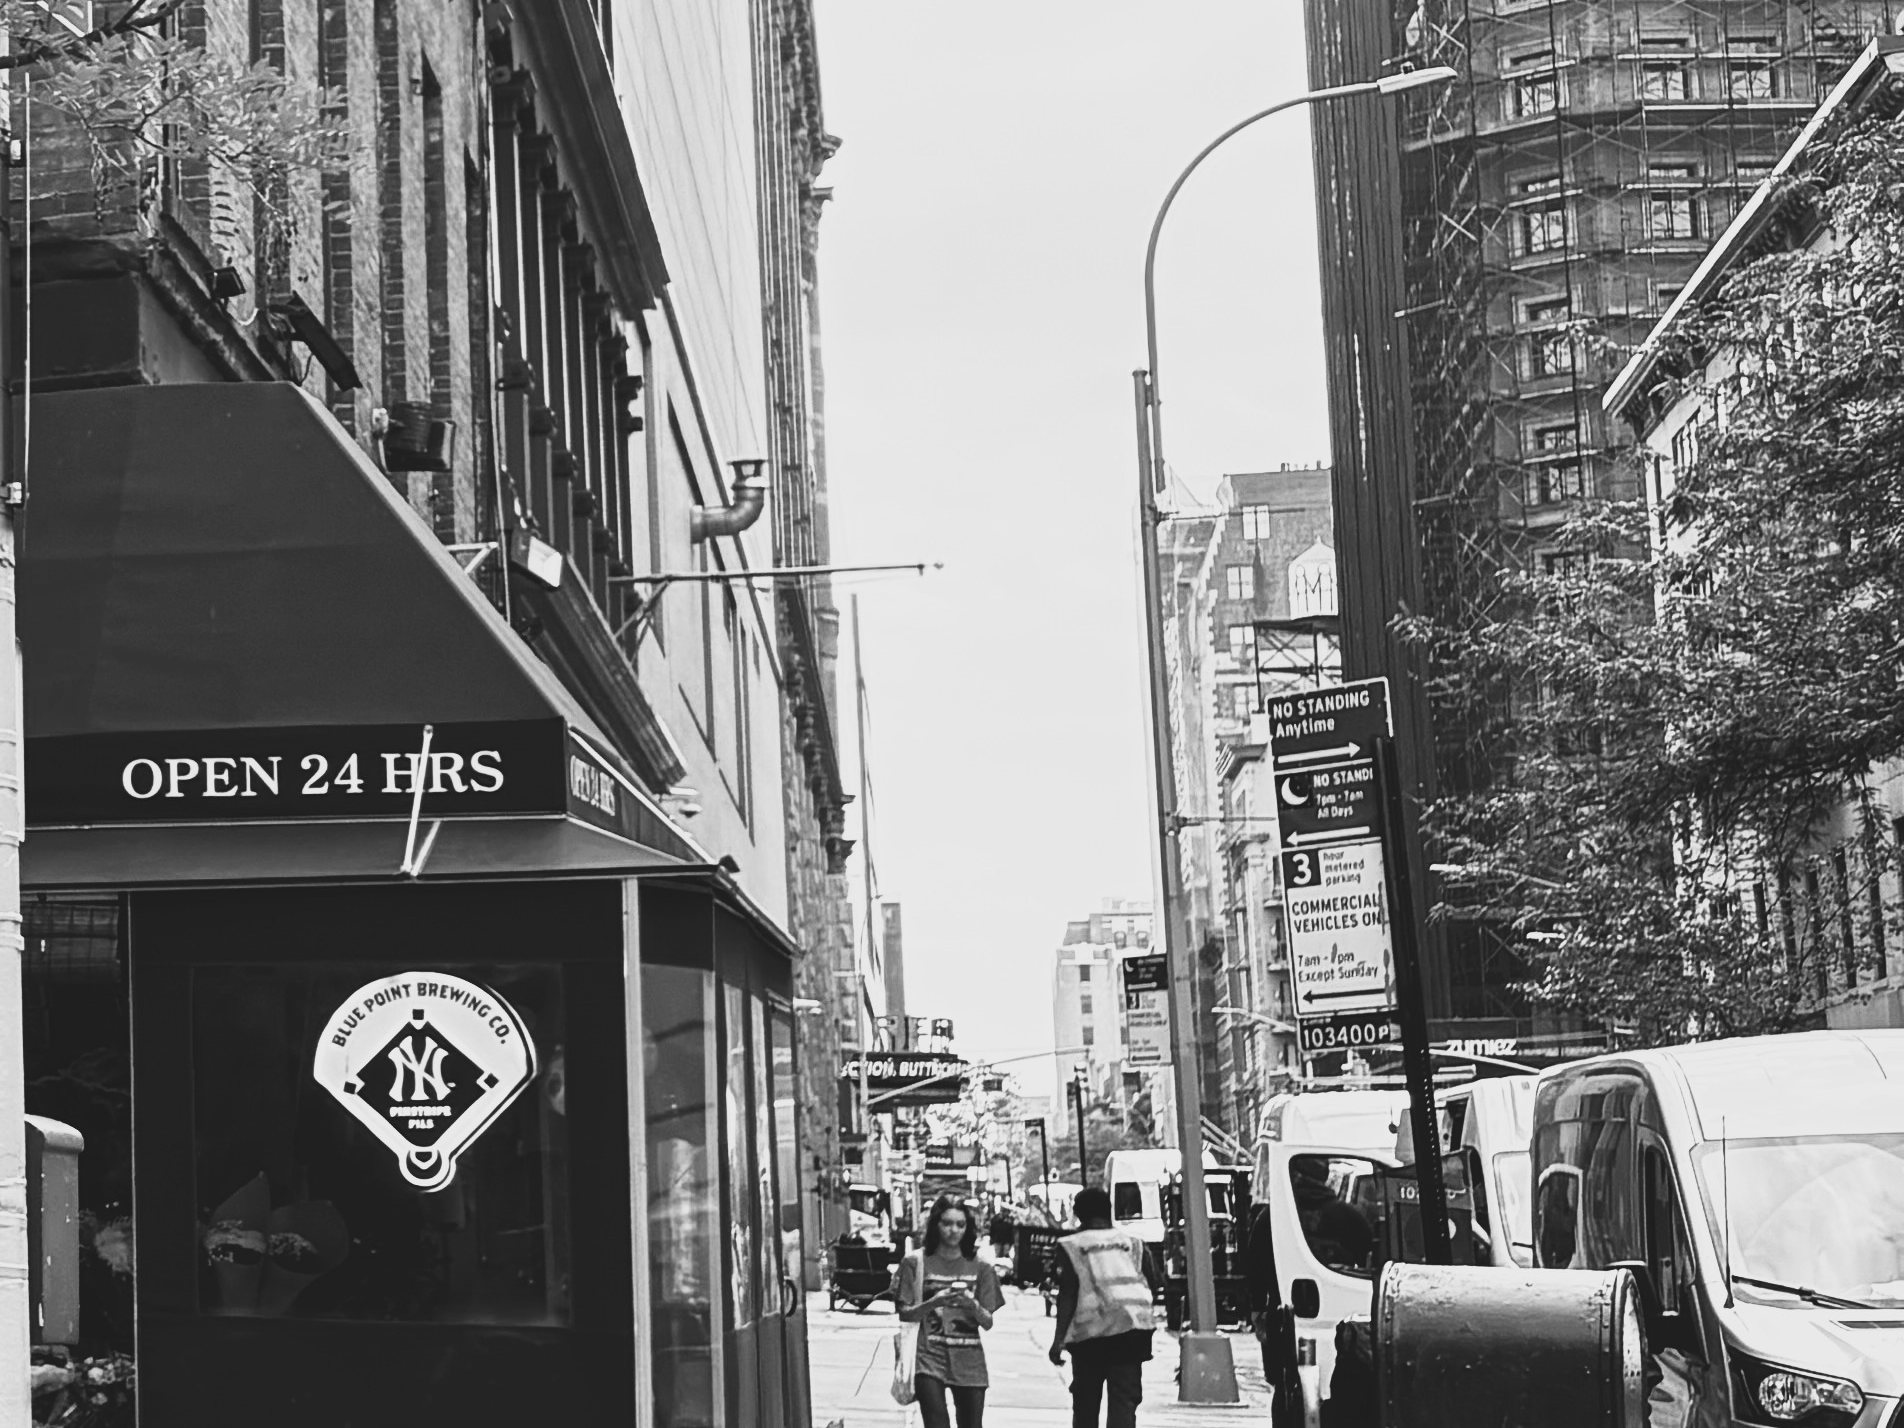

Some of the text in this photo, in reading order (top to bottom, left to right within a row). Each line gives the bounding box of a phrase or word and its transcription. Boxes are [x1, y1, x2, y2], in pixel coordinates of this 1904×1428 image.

[1273, 690, 1370, 720] NO STANDING
[1276, 718, 1335, 739] Anytime
[121, 749, 505, 800] OPEN 24 HRS
[1313, 773, 1330, 788] NO
[1292, 853, 1312, 885] 3
[1292, 893, 1380, 916] COMMERCIAL
[1293, 914, 1359, 933] VEHICLES
[1298, 968, 1335, 983] Except
[332, 983, 510, 1047] BLUE POINT BREWING CO.
[1445, 1039, 1517, 1056] zumiez
